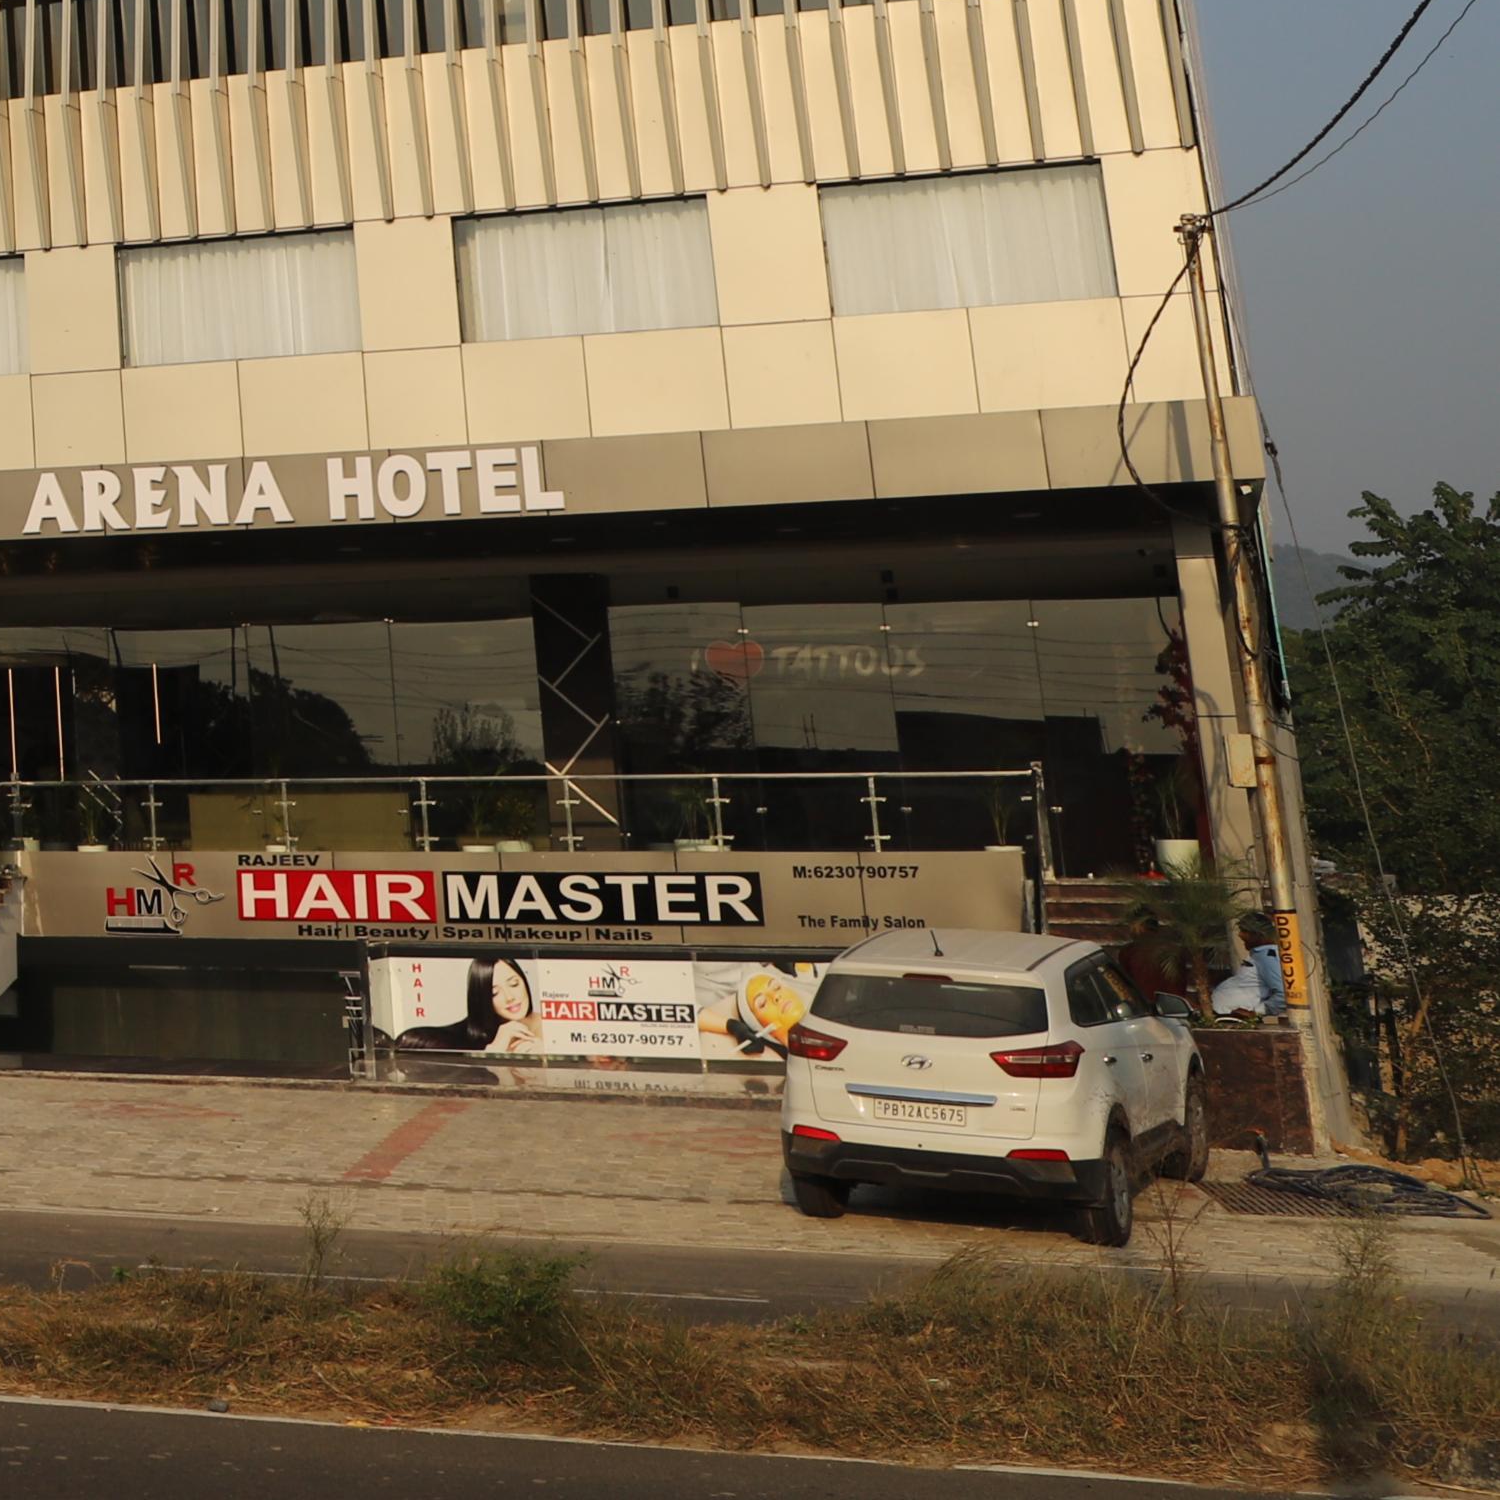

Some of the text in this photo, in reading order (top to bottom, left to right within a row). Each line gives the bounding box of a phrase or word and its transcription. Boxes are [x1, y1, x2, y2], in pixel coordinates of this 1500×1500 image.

[23, 460, 295, 536] ARENA
[326, 446, 566, 521] HOTEL
[237, 853, 319, 868] RAJEEV
[792, 865, 920, 879] M:6230790757
[106, 888, 165, 917] HM
[241, 873, 760, 923] HAIR MASTER
[798, 914, 926, 931] The Family Salon
[298, 924, 654, 943] Hair Beauty Spa Makeup Nails
[410, 963, 427, 1018] HAIR
[588, 977, 616, 989] HM
[541, 1002, 692, 1022] HAIR MASTER
[570, 1032, 684, 1046] M: 62307-90757
[883, 1102, 964, 1122] PB12AC5675
